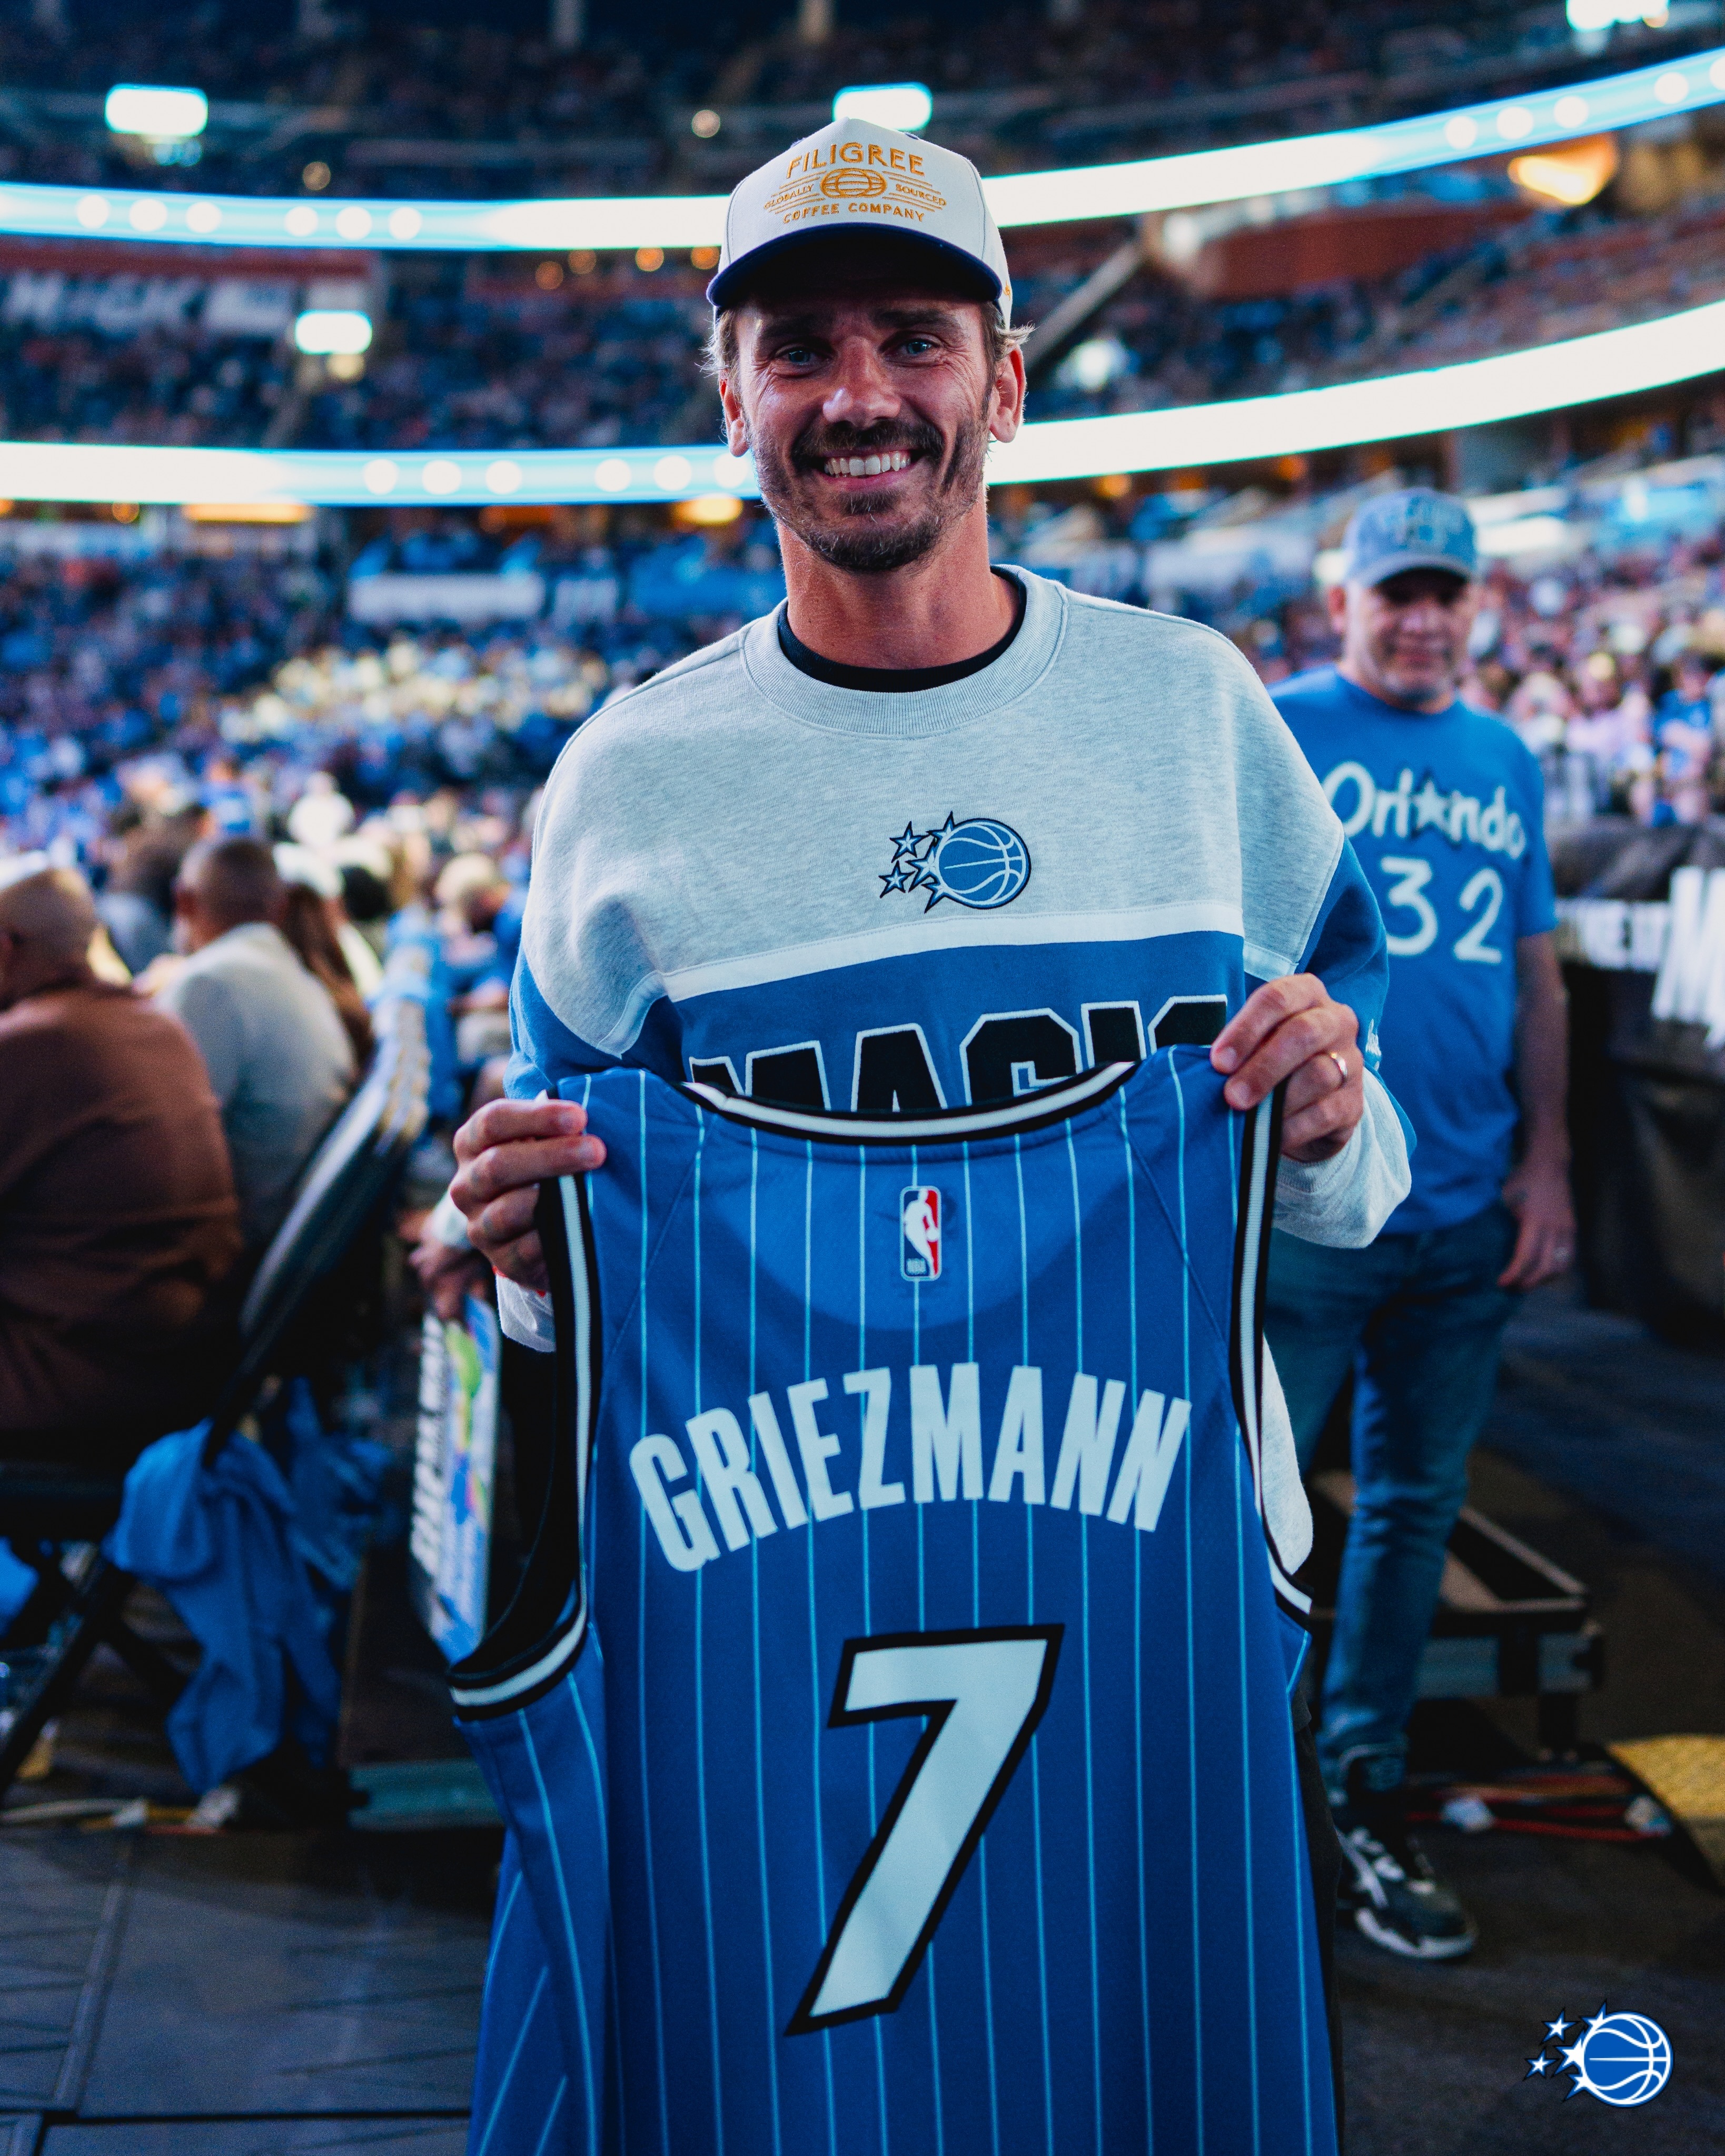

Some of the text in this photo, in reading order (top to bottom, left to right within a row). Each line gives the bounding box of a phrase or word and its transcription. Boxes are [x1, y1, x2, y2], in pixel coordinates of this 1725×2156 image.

[765, 184, 946, 208] GLOBALLY SOURCED
[787, 142, 925, 178] FILIGREE
[783, 203, 924, 223] COFFEE COMPANY
[1380, 855, 1504, 966] 32
[630, 1362, 1192, 1572] GRIEZMANN
[784, 1623, 1065, 2037] 7
